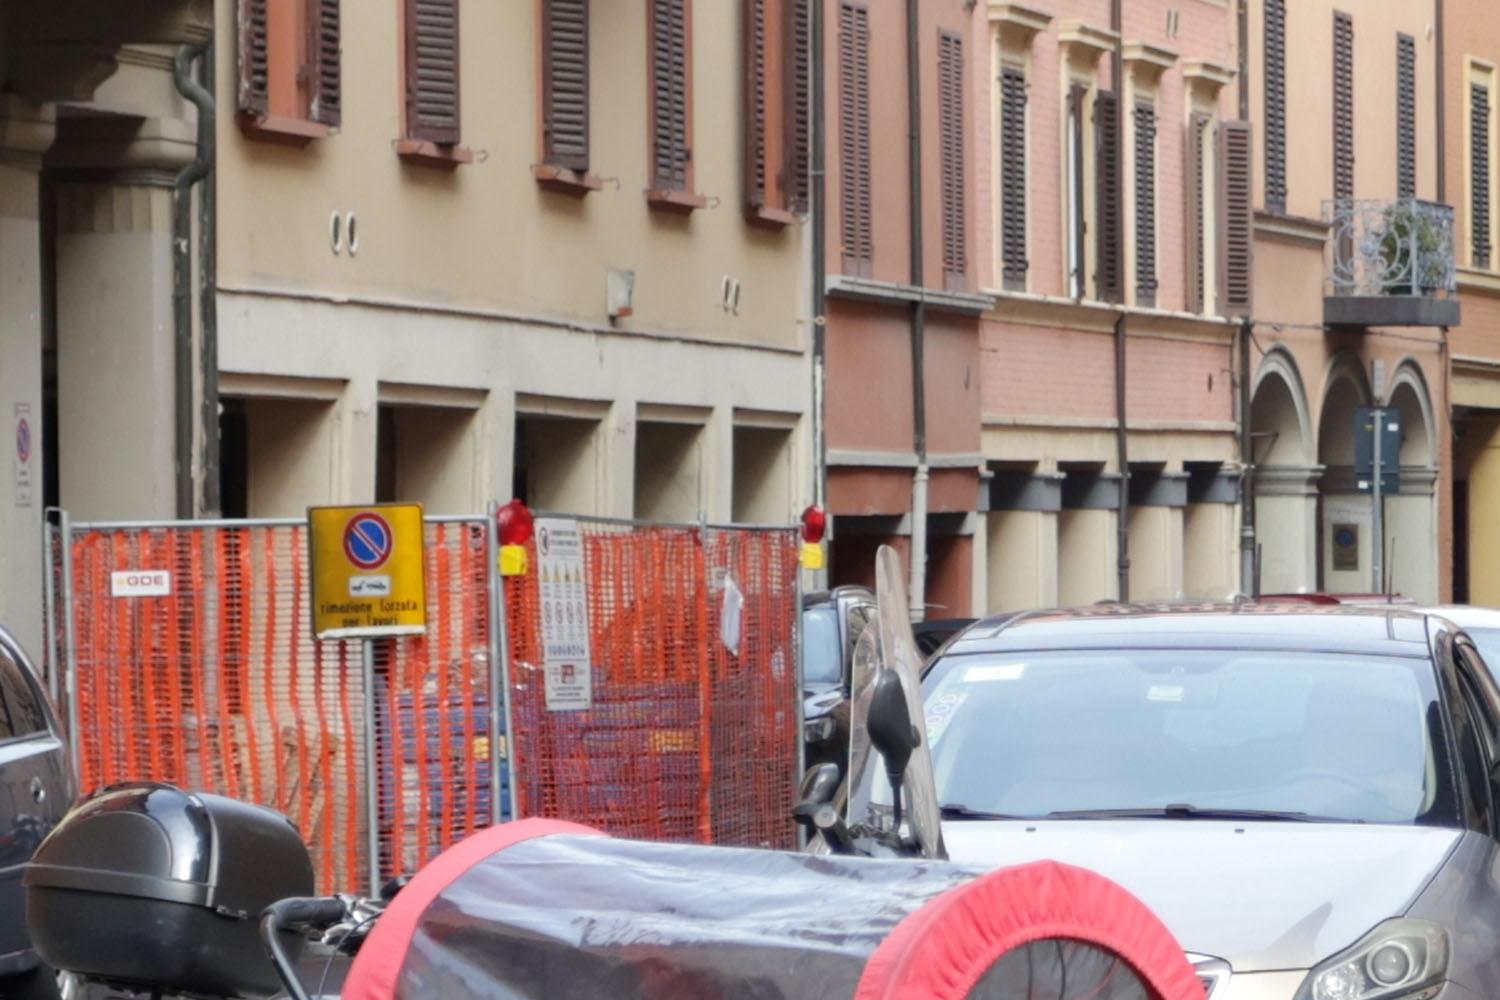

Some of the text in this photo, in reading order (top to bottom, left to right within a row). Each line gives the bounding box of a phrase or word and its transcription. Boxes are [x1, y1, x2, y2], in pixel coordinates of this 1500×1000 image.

[320, 599, 417, 613] rimozione forzata
[367, 614, 398, 626] lavori
